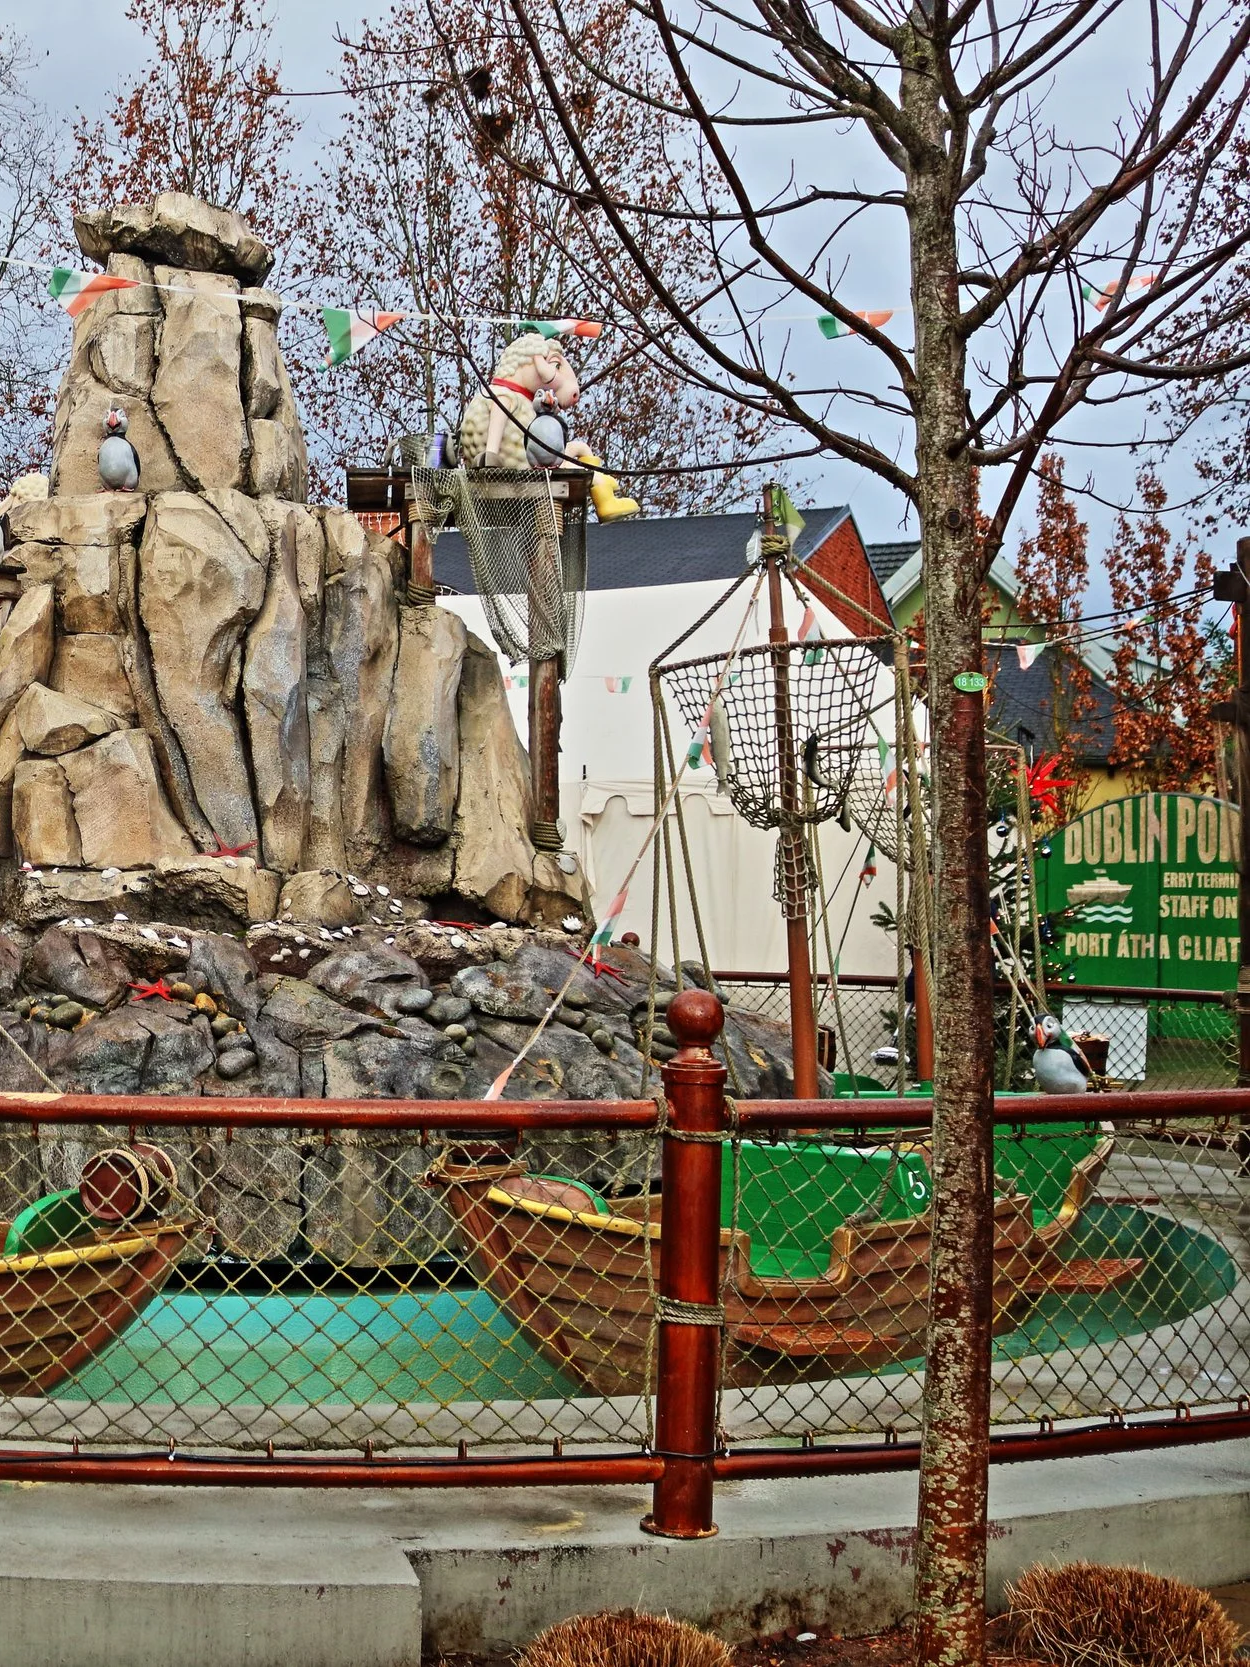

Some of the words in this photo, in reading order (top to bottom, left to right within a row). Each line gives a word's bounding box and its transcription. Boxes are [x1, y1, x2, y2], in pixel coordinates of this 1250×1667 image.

[957, 678, 967, 687] 18
[970, 678, 985, 687] 133
[1064, 794, 1168, 865] DUBLIN
[1159, 895, 1209, 918] STAFF
[1065, 932, 1112, 957] PORT
